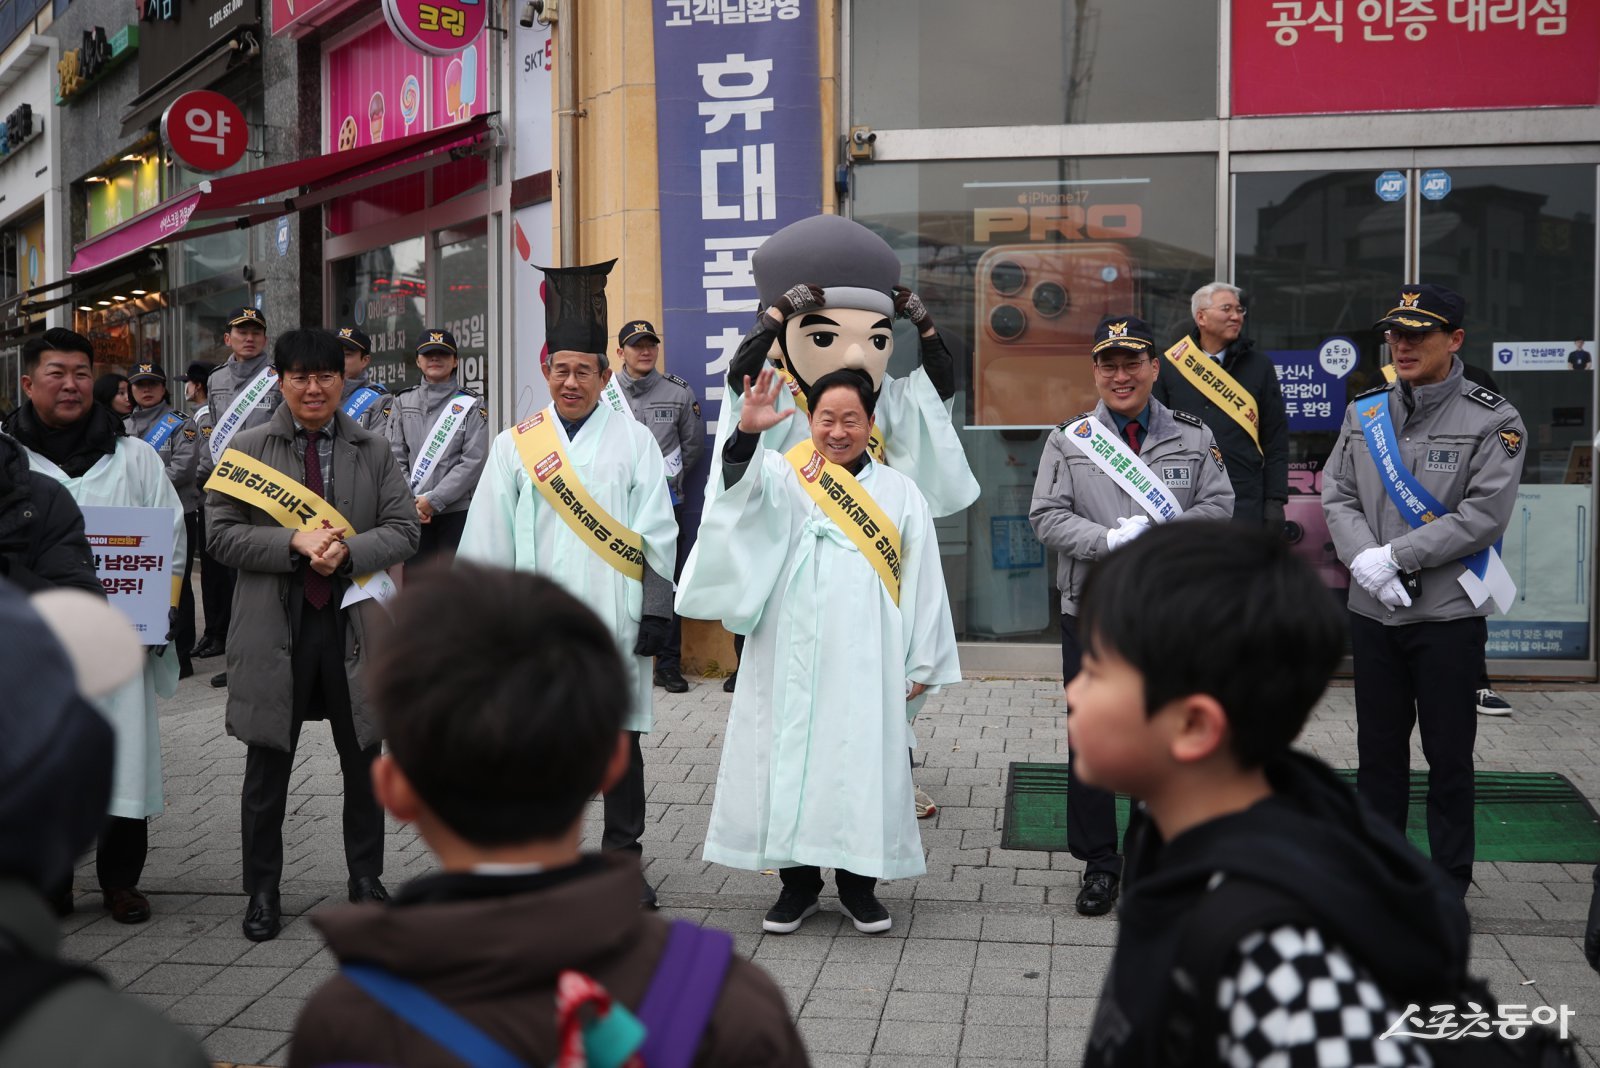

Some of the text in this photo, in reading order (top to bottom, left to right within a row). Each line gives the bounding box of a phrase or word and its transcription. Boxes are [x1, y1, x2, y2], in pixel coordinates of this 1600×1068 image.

[418, 4, 466, 37] 크림
[1266, 0, 1343, 46] 공식
[1357, 0, 1438, 42] 인증
[524, 50, 544, 73] SKT
[185, 108, 231, 156] 약
[1381, 180, 1402, 191] ADT
[1424, 178, 1447, 190] ADT
[973, 203, 1143, 242] PRO
[1325, 344, 1351, 357] 모두의
[1326, 358, 1349, 370] 매장
[368, 362, 406, 384] 간편간식
[1184, 354, 1247, 412] 아동안전도시
[1302, 401, 1332, 418] 환영
[1090, 433, 1116, 460] 시민과
[1109, 453, 1132, 474] 함께
[1124, 466, 1152, 494] 만드는
[1428, 463, 1457, 471] POLICE
[216, 460, 318, 526] 아동안전도시
[818, 471, 881, 539] 등하굣길이
[1394, 480, 1427, 514] 우리동네
[549, 474, 613, 544] 등하굣길이
[104, 553, 164, 572] 남양주!
[100, 577, 144, 595] 양주!
